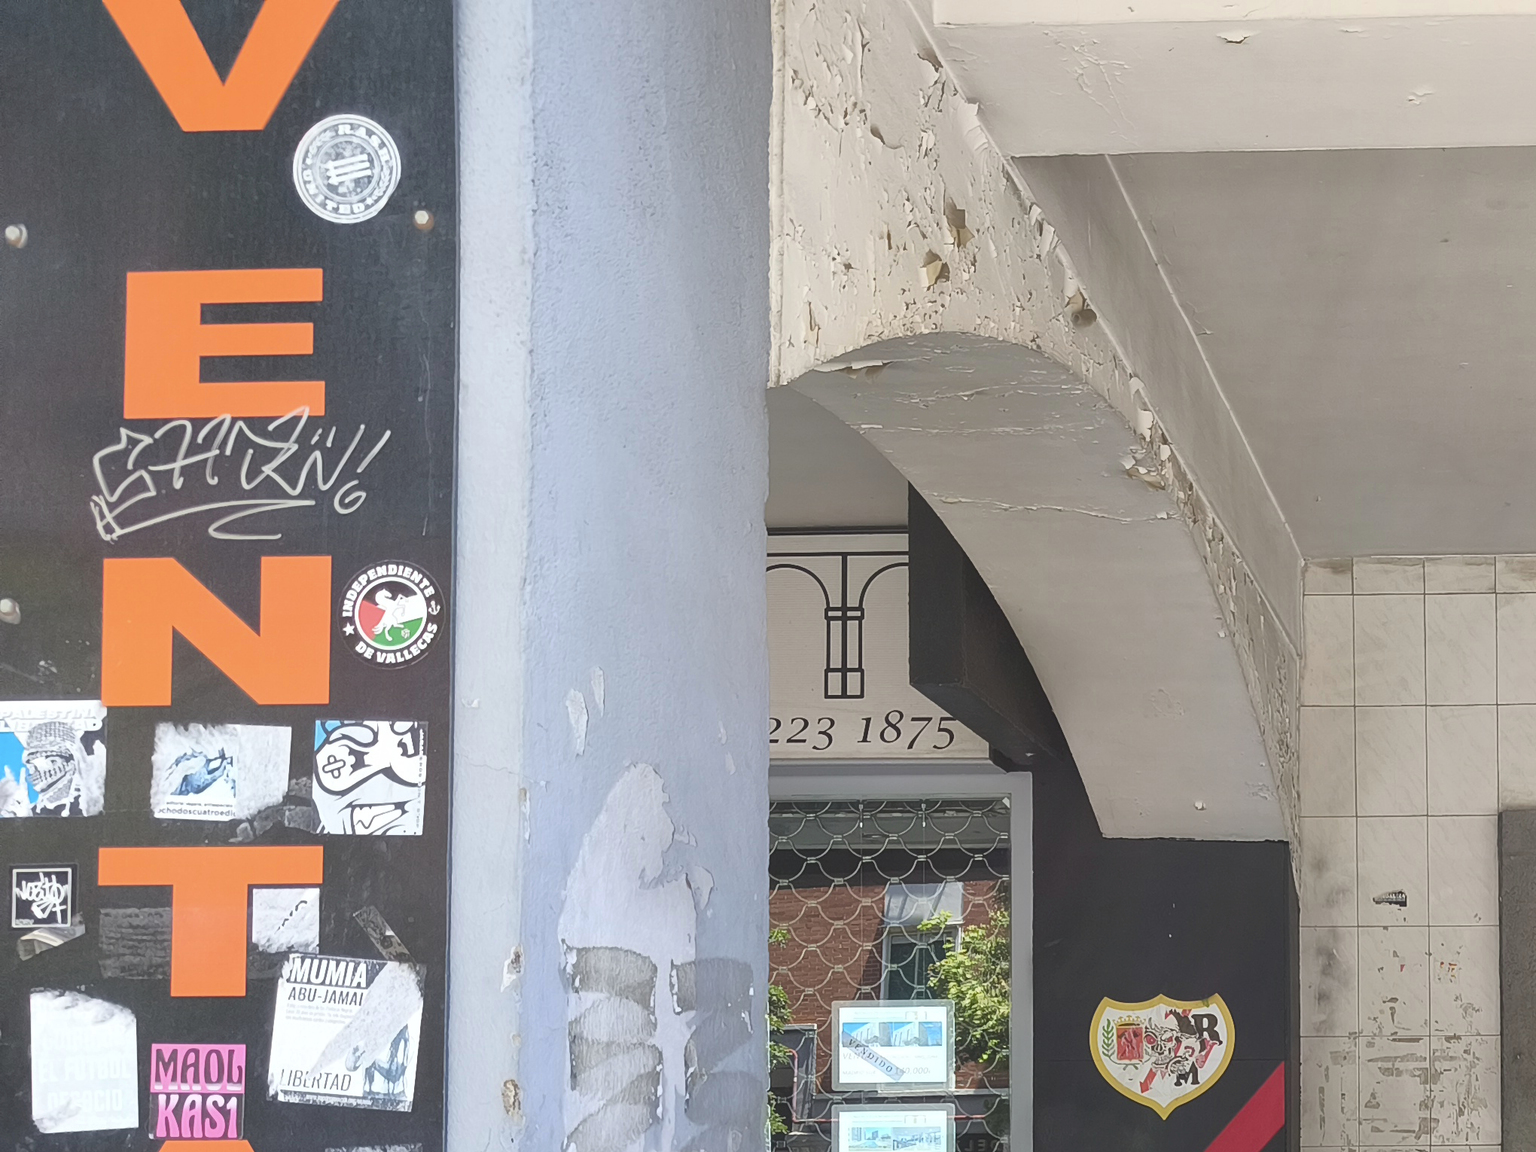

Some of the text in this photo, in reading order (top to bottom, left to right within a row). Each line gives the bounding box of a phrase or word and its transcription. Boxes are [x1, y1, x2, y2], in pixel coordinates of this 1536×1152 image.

[341, 563, 436, 618] INDEPENDIENTE
[354, 621, 439, 664] DE VALLECAS
[857, 709, 957, 750] 1875
[290, 957, 368, 988] MUMIA
[154, 1047, 244, 1092] MAOL
